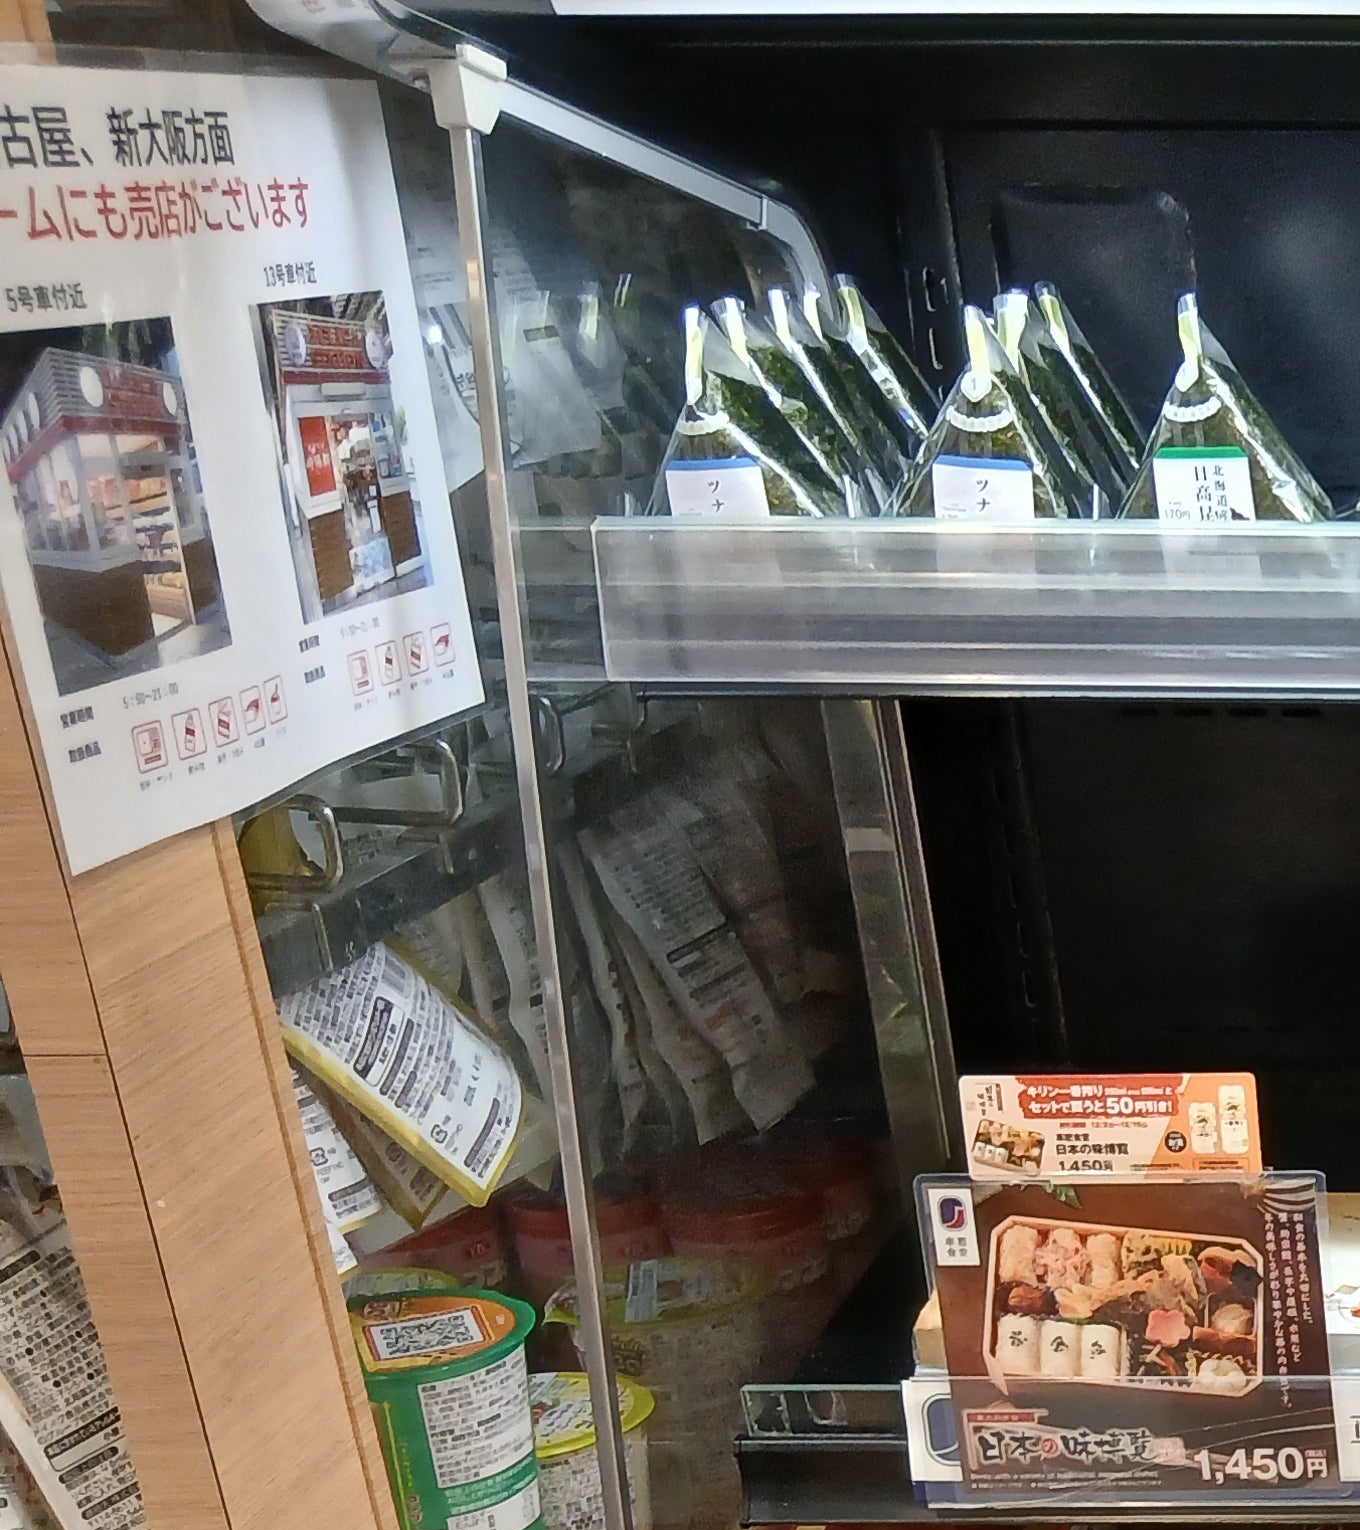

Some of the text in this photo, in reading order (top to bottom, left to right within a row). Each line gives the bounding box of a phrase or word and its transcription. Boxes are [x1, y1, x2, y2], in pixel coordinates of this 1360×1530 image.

[0, 105, 235, 168] 古屋、新大阪方面
[263, 261, 317, 287] 13号車付近
[5, 283, 87, 312] 5号車付近
[707, 479, 725, 513] ツナ
[975, 479, 991, 512] ツナ
